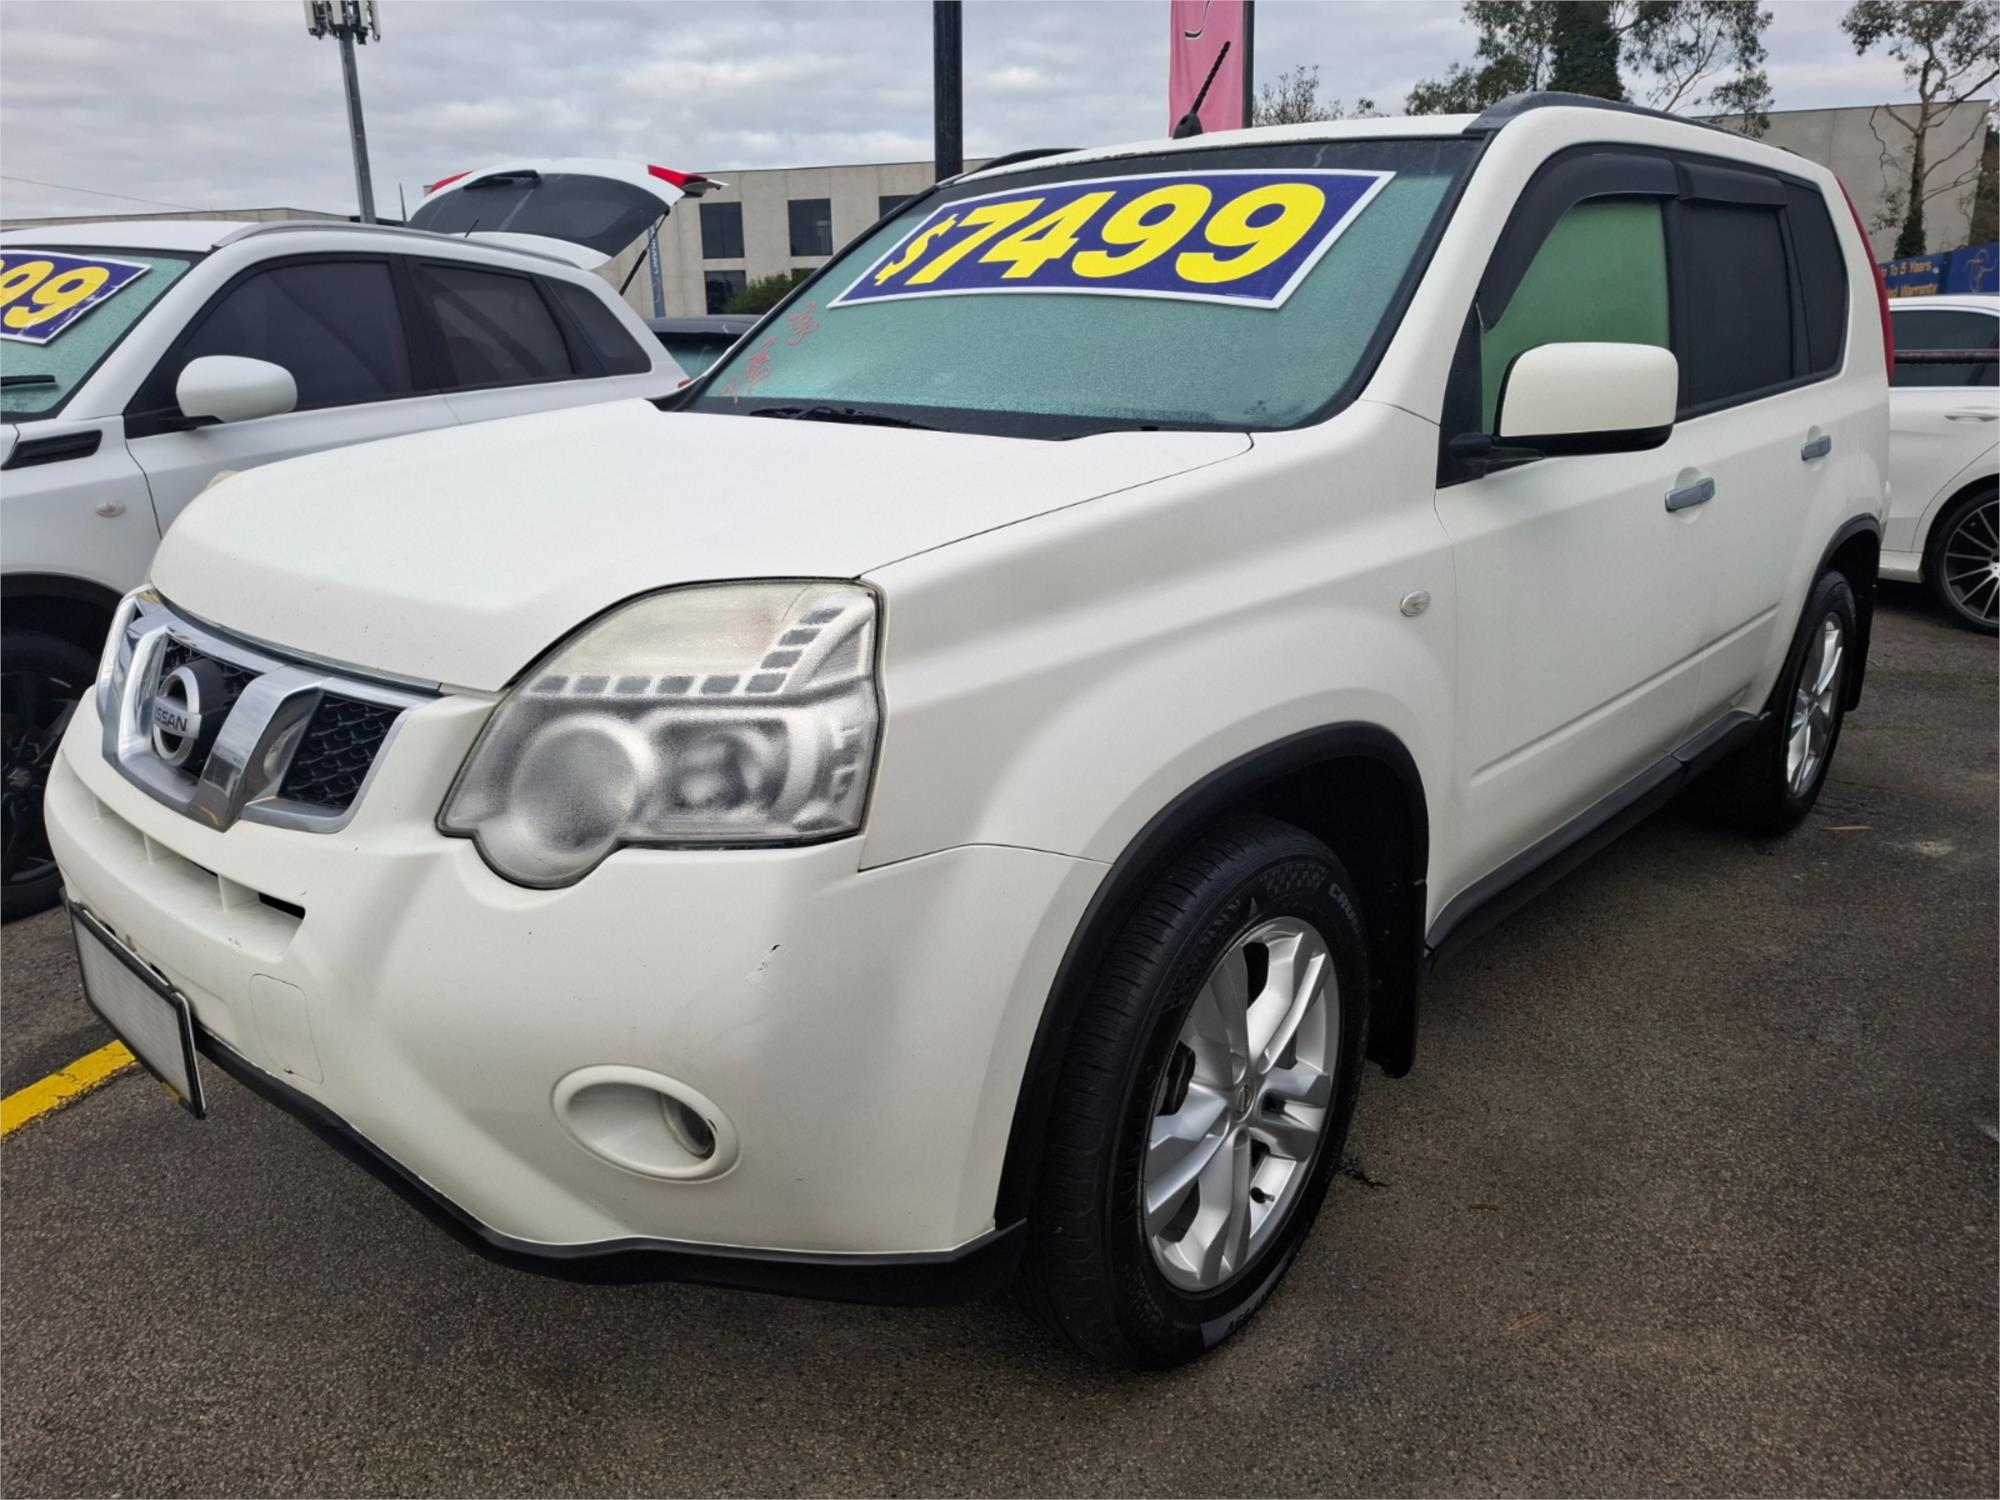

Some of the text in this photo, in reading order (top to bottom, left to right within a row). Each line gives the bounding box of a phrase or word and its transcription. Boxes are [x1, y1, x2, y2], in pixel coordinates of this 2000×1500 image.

[874, 183, 1326, 287] $7499
[1900, 261, 1907, 275] 5
[1909, 260, 1932, 273] Years
[0, 258, 110, 328] 99
[154, 707, 188, 732] SSAN
